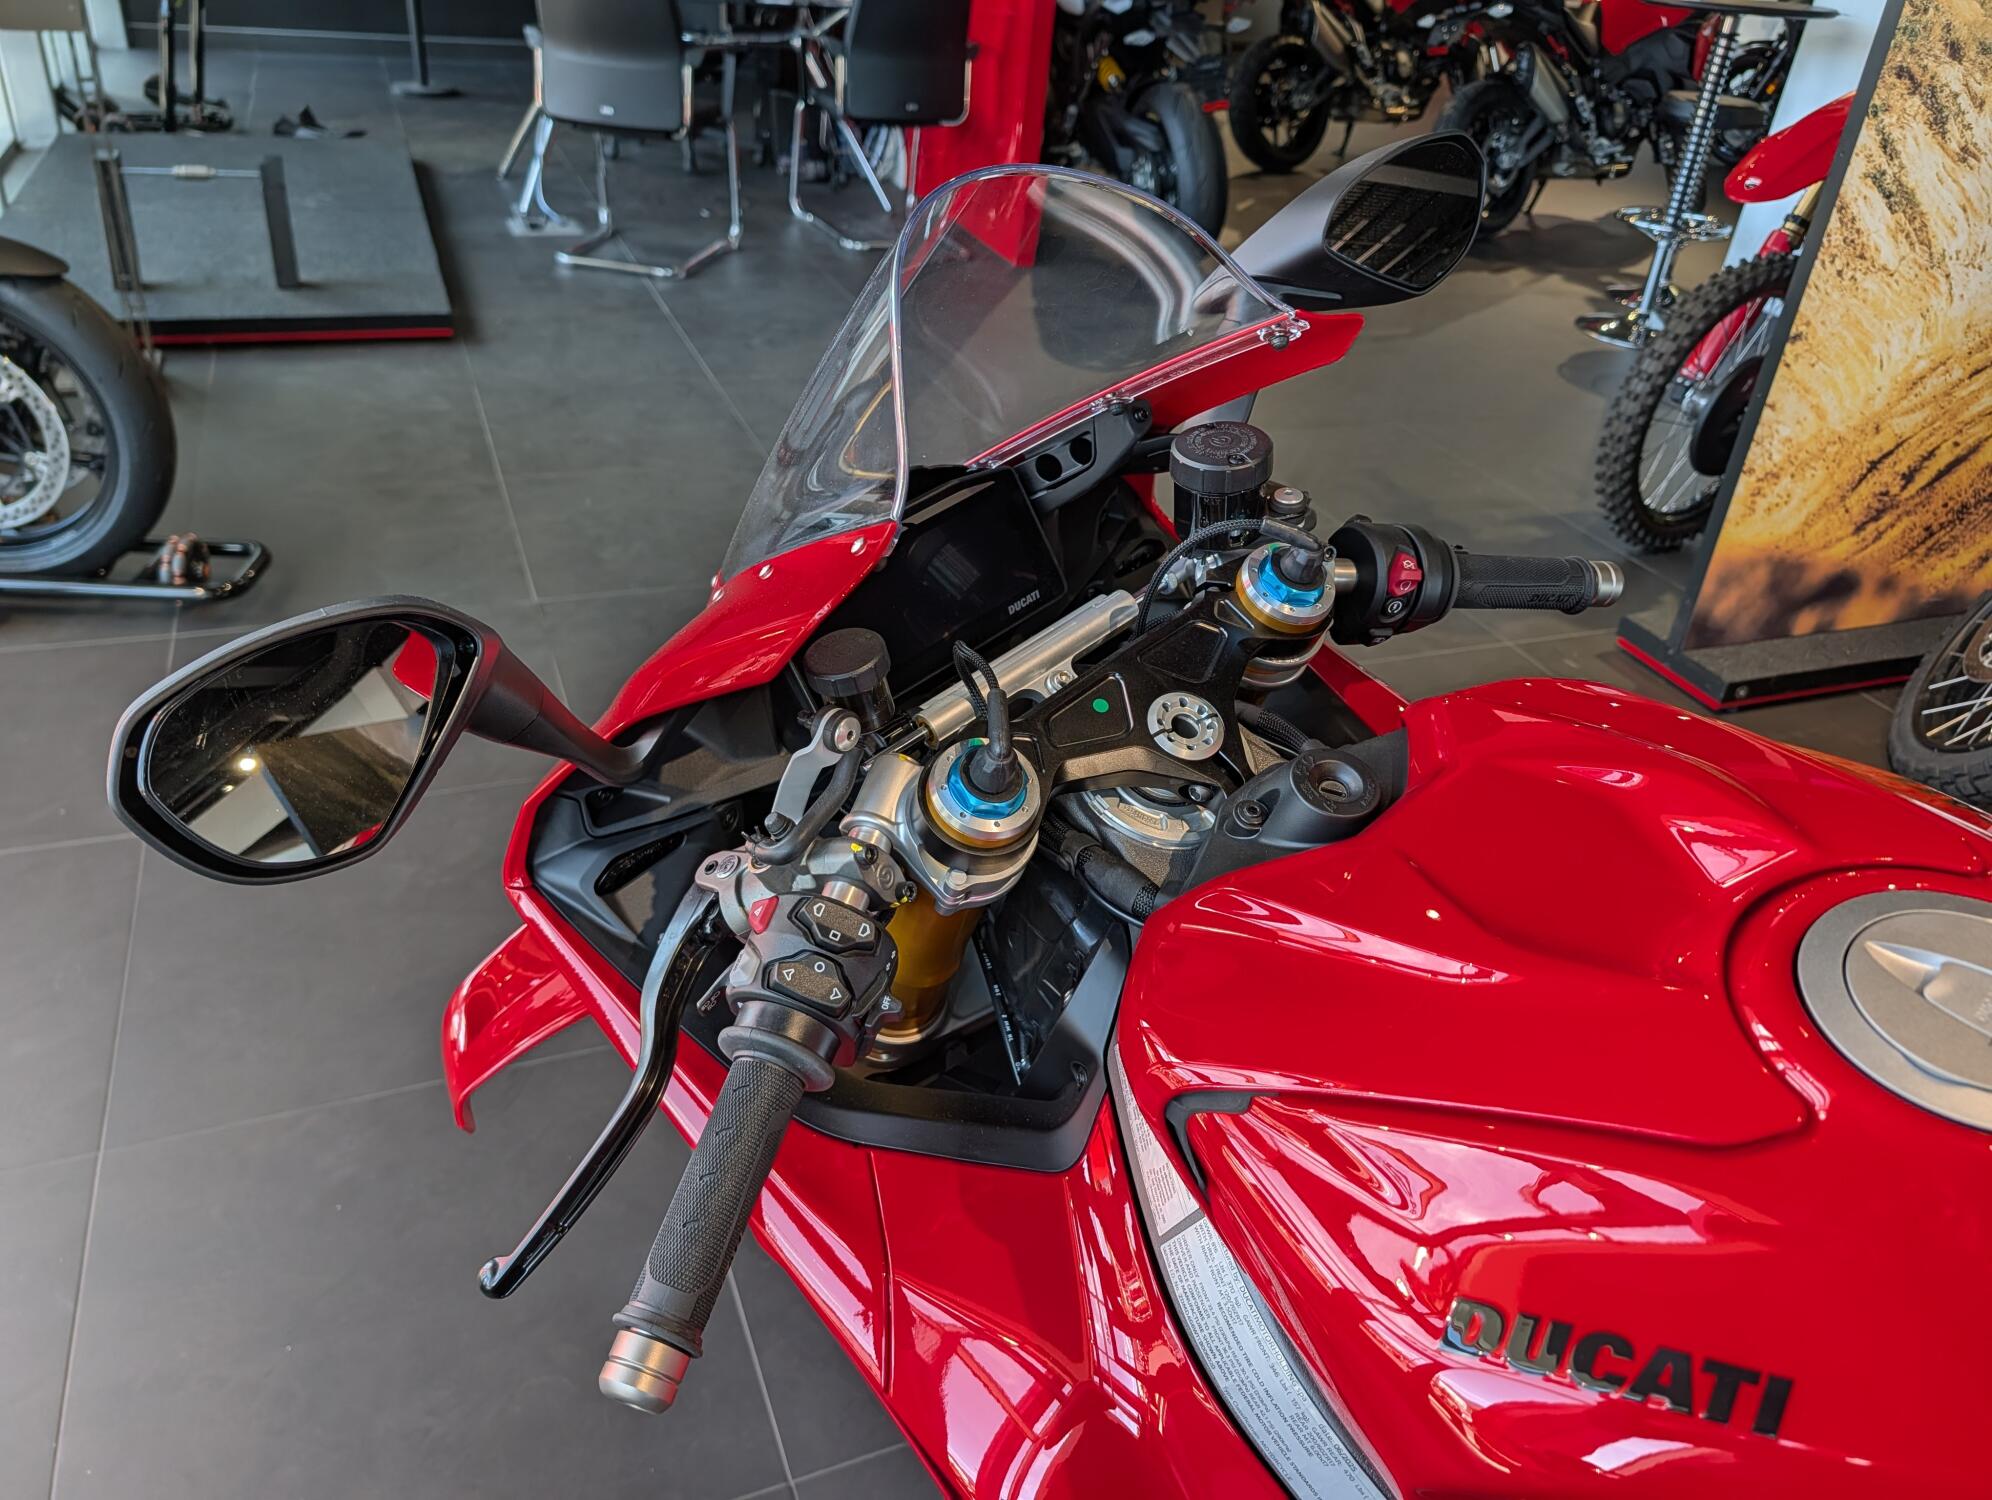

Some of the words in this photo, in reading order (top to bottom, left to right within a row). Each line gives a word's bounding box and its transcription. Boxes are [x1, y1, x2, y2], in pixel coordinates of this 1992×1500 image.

[1008, 590, 1040, 615] DUCATI
[881, 995, 891, 1010] OFF
[1165, 1243, 1174, 1257] THE
[1170, 1257, 1180, 1273] DATE
[1176, 1273, 1184, 1284] OF
[1180, 1283, 1205, 1333] MANUFACTURE
[1201, 1333, 1218, 1359] SHOWN
[1214, 1359, 1230, 1383] ABOVE
[1170, 1240, 1180, 1255] THIS
[1175, 1255, 1190, 1283] VEHICLE
[1185, 1282, 1206, 1321] CONFORMS
[1202, 1321, 1210, 1331] TO
[1206, 1331, 1216, 1344] ALL
[1213, 1343, 1238, 1383] APPLICABLE
[1234, 1382, 1256, 1412] FEDERAL
[1254, 1411, 1272, 1436] MOTOR
[1270, 1434, 1292, 1462] VEHICLE
[1288, 1461, 1319, 1497] STANDARDS
[1441, 1298, 1793, 1440] DUCATI
[1238, 1284, 1299, 1387] DUCATIMOTORHOLDING
[1332, 1442, 1358, 1473] 06/2025
[1241, 1351, 1254, 1368] TIRE
[1250, 1367, 1265, 1387] COLD
[1262, 1386, 1288, 1423] INFLATION
[1286, 1422, 1314, 1458] PRESSURE
[1267, 1362, 1281, 1378] 346
[1290, 1397, 1301, 1411] 157
